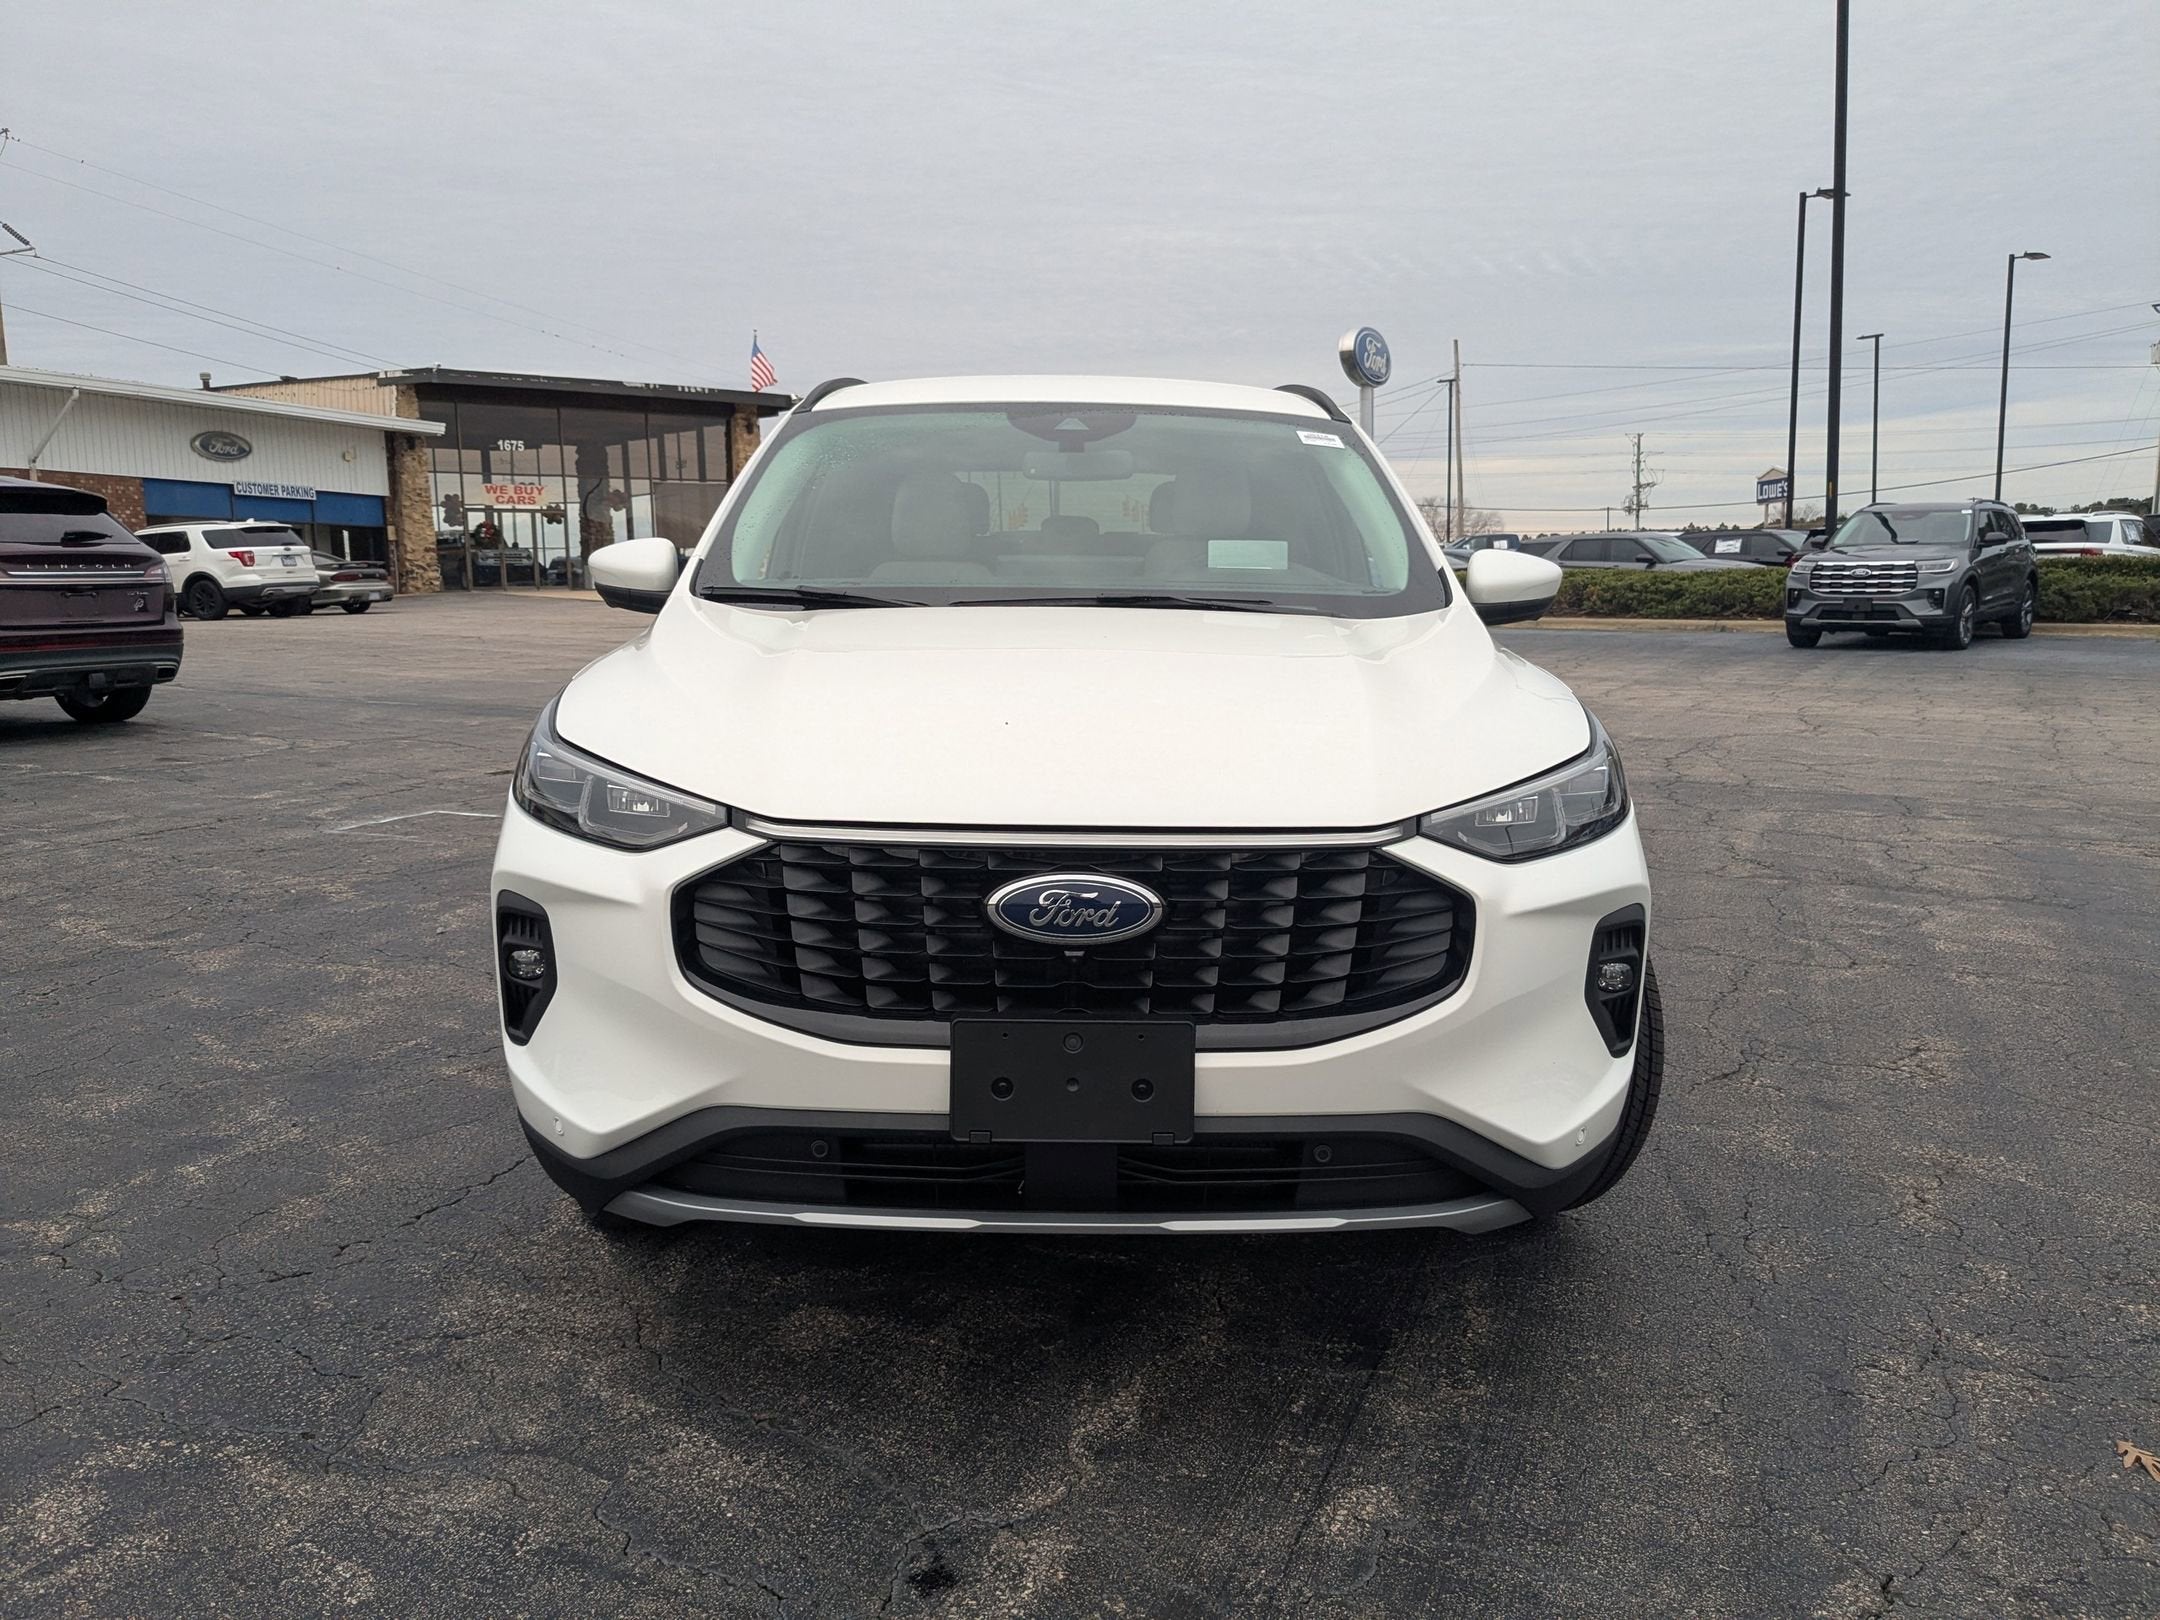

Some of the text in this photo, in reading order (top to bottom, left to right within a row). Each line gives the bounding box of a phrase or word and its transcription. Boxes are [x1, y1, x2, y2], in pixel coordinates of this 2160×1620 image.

[1364, 336, 1387, 375] Ford
[208, 439, 240, 456] Ford
[497, 439, 525, 452] 1675
[236, 481, 315, 499] CUSTOMER PARKING
[484, 485, 545, 496] WE BUY
[1757, 480, 1788, 500] LOWE'S
[495, 495, 537, 505] CARS
[1028, 889, 1122, 928] Ford
